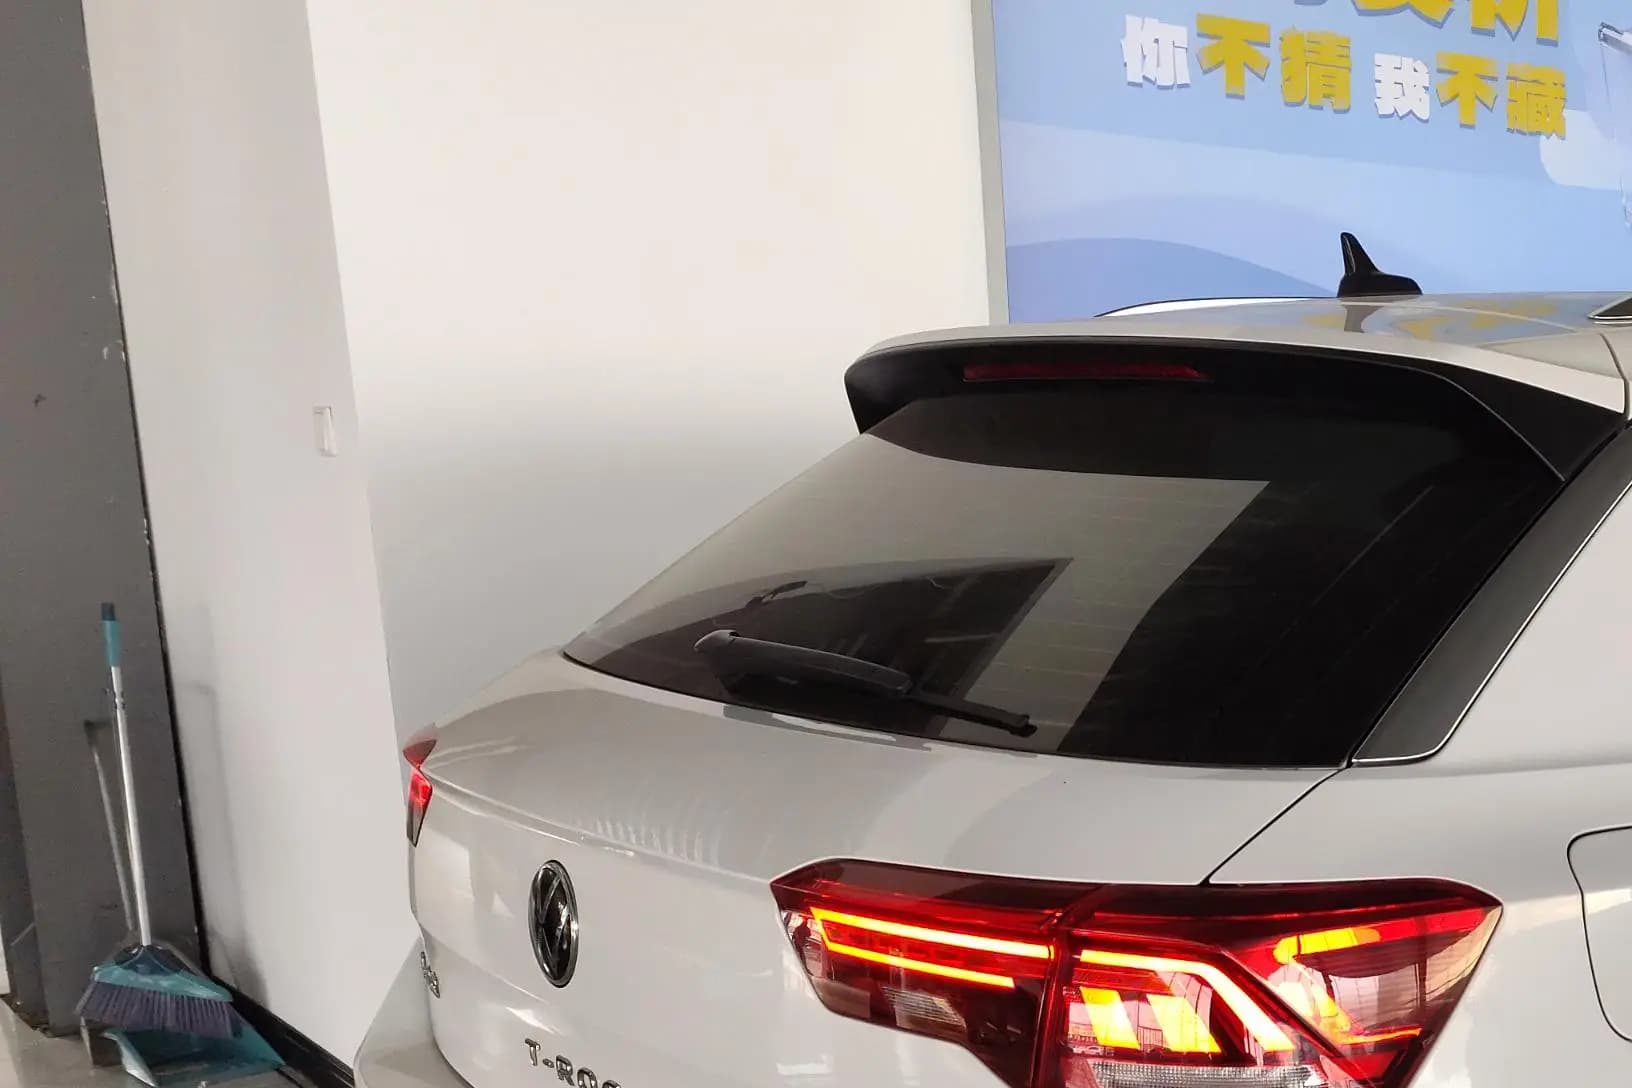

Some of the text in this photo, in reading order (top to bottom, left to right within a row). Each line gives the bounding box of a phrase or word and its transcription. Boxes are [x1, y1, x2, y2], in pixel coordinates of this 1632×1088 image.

[1121, 13, 1352, 114] 你不猜
[1373, 52, 1567, 140] 我不藏
